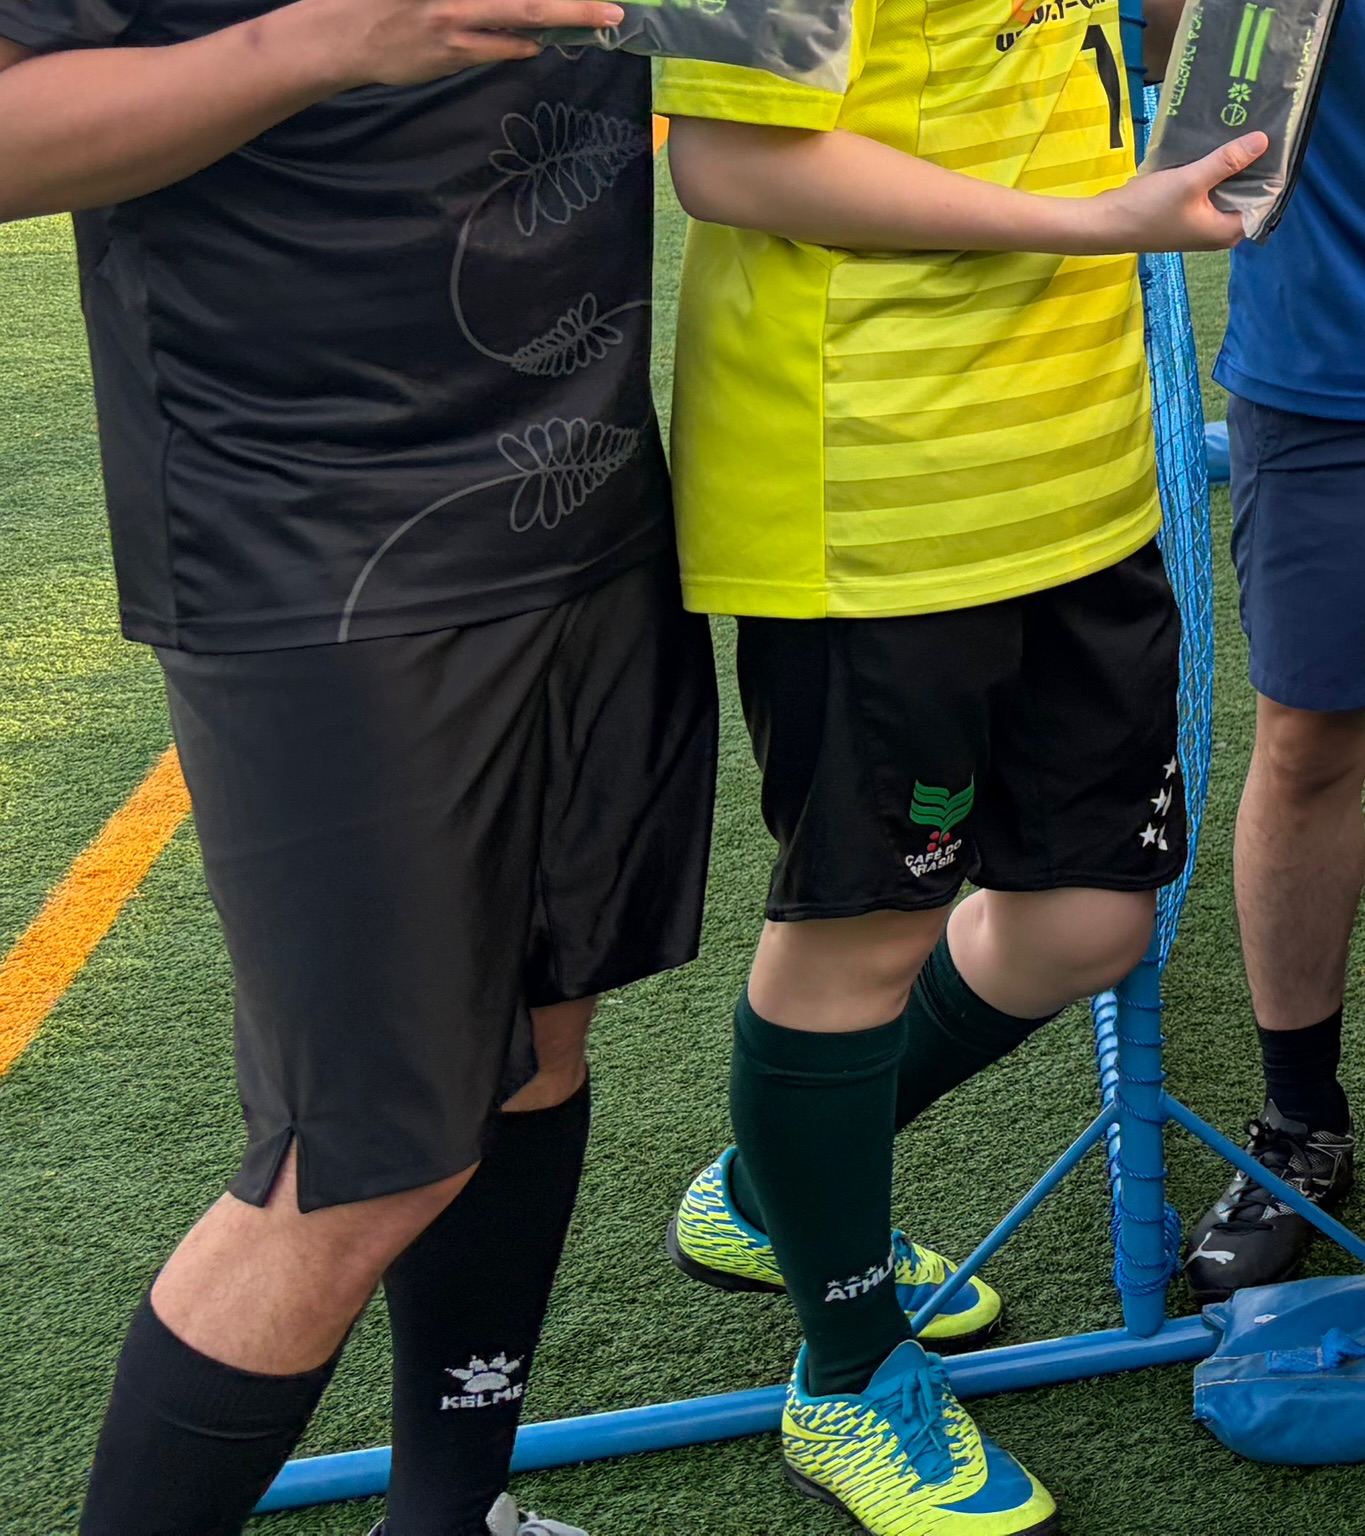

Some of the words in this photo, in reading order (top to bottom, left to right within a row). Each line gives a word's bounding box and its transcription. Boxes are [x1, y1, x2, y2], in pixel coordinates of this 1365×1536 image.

[945, 839, 962, 855] DO
[910, 853, 956, 878] BRASIL
[440, 1383, 523, 1410] KELME
